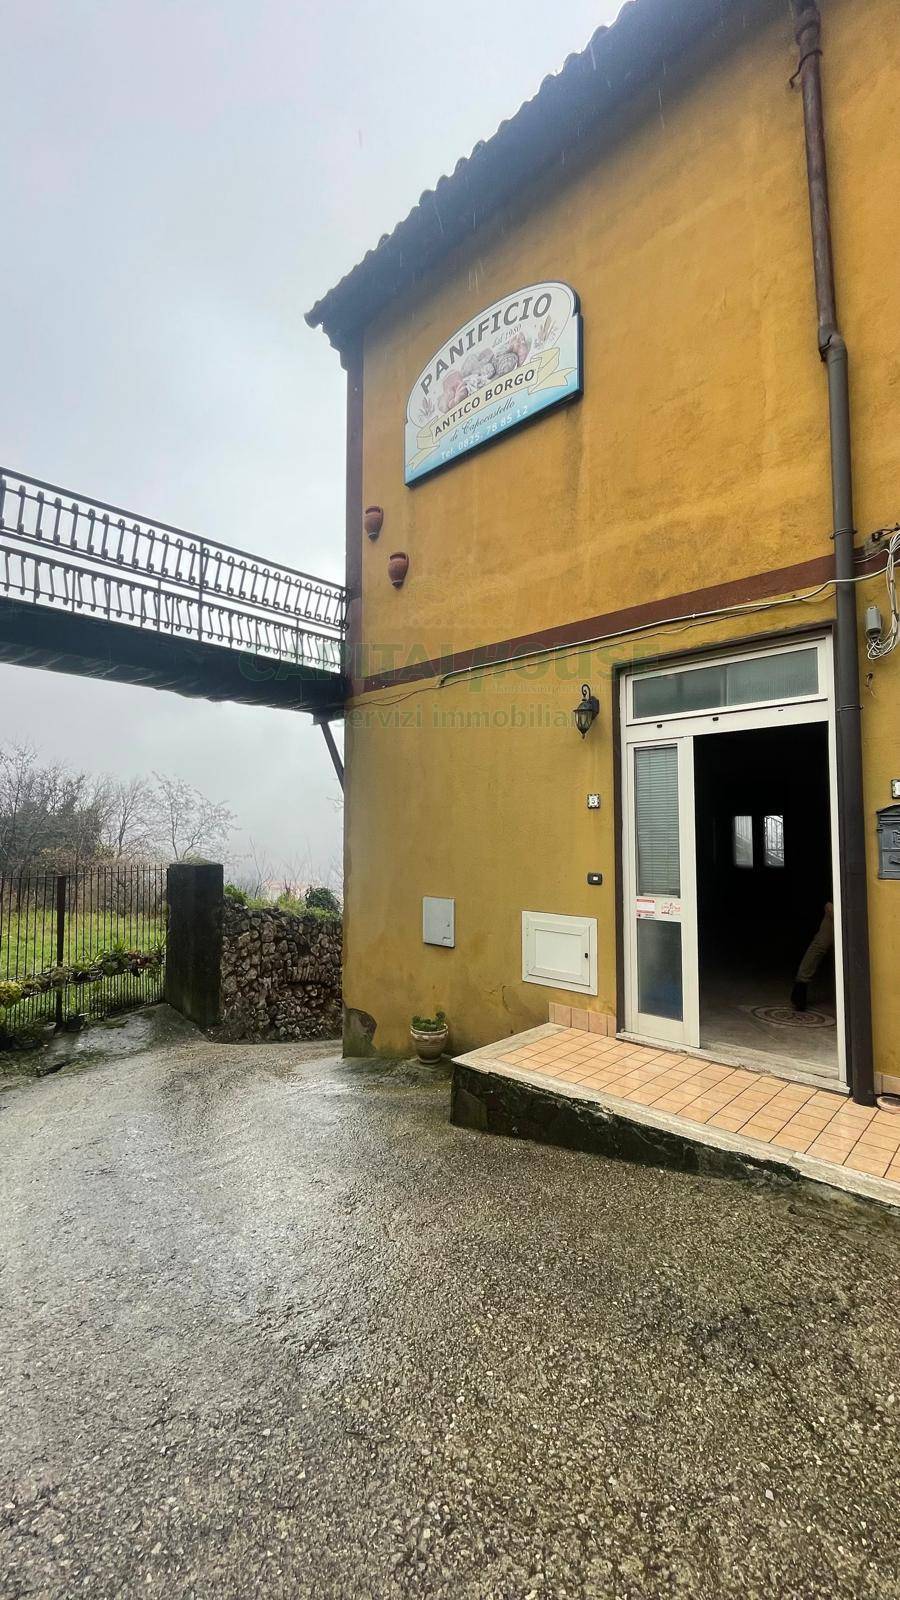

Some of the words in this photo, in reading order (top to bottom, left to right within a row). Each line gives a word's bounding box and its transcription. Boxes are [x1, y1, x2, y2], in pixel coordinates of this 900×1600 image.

[420, 293, 552, 395] PANIFICIO
[434, 396, 480, 437] ANTICO
[485, 369, 536, 402] BORGO
[515, 405, 528, 419] 12
